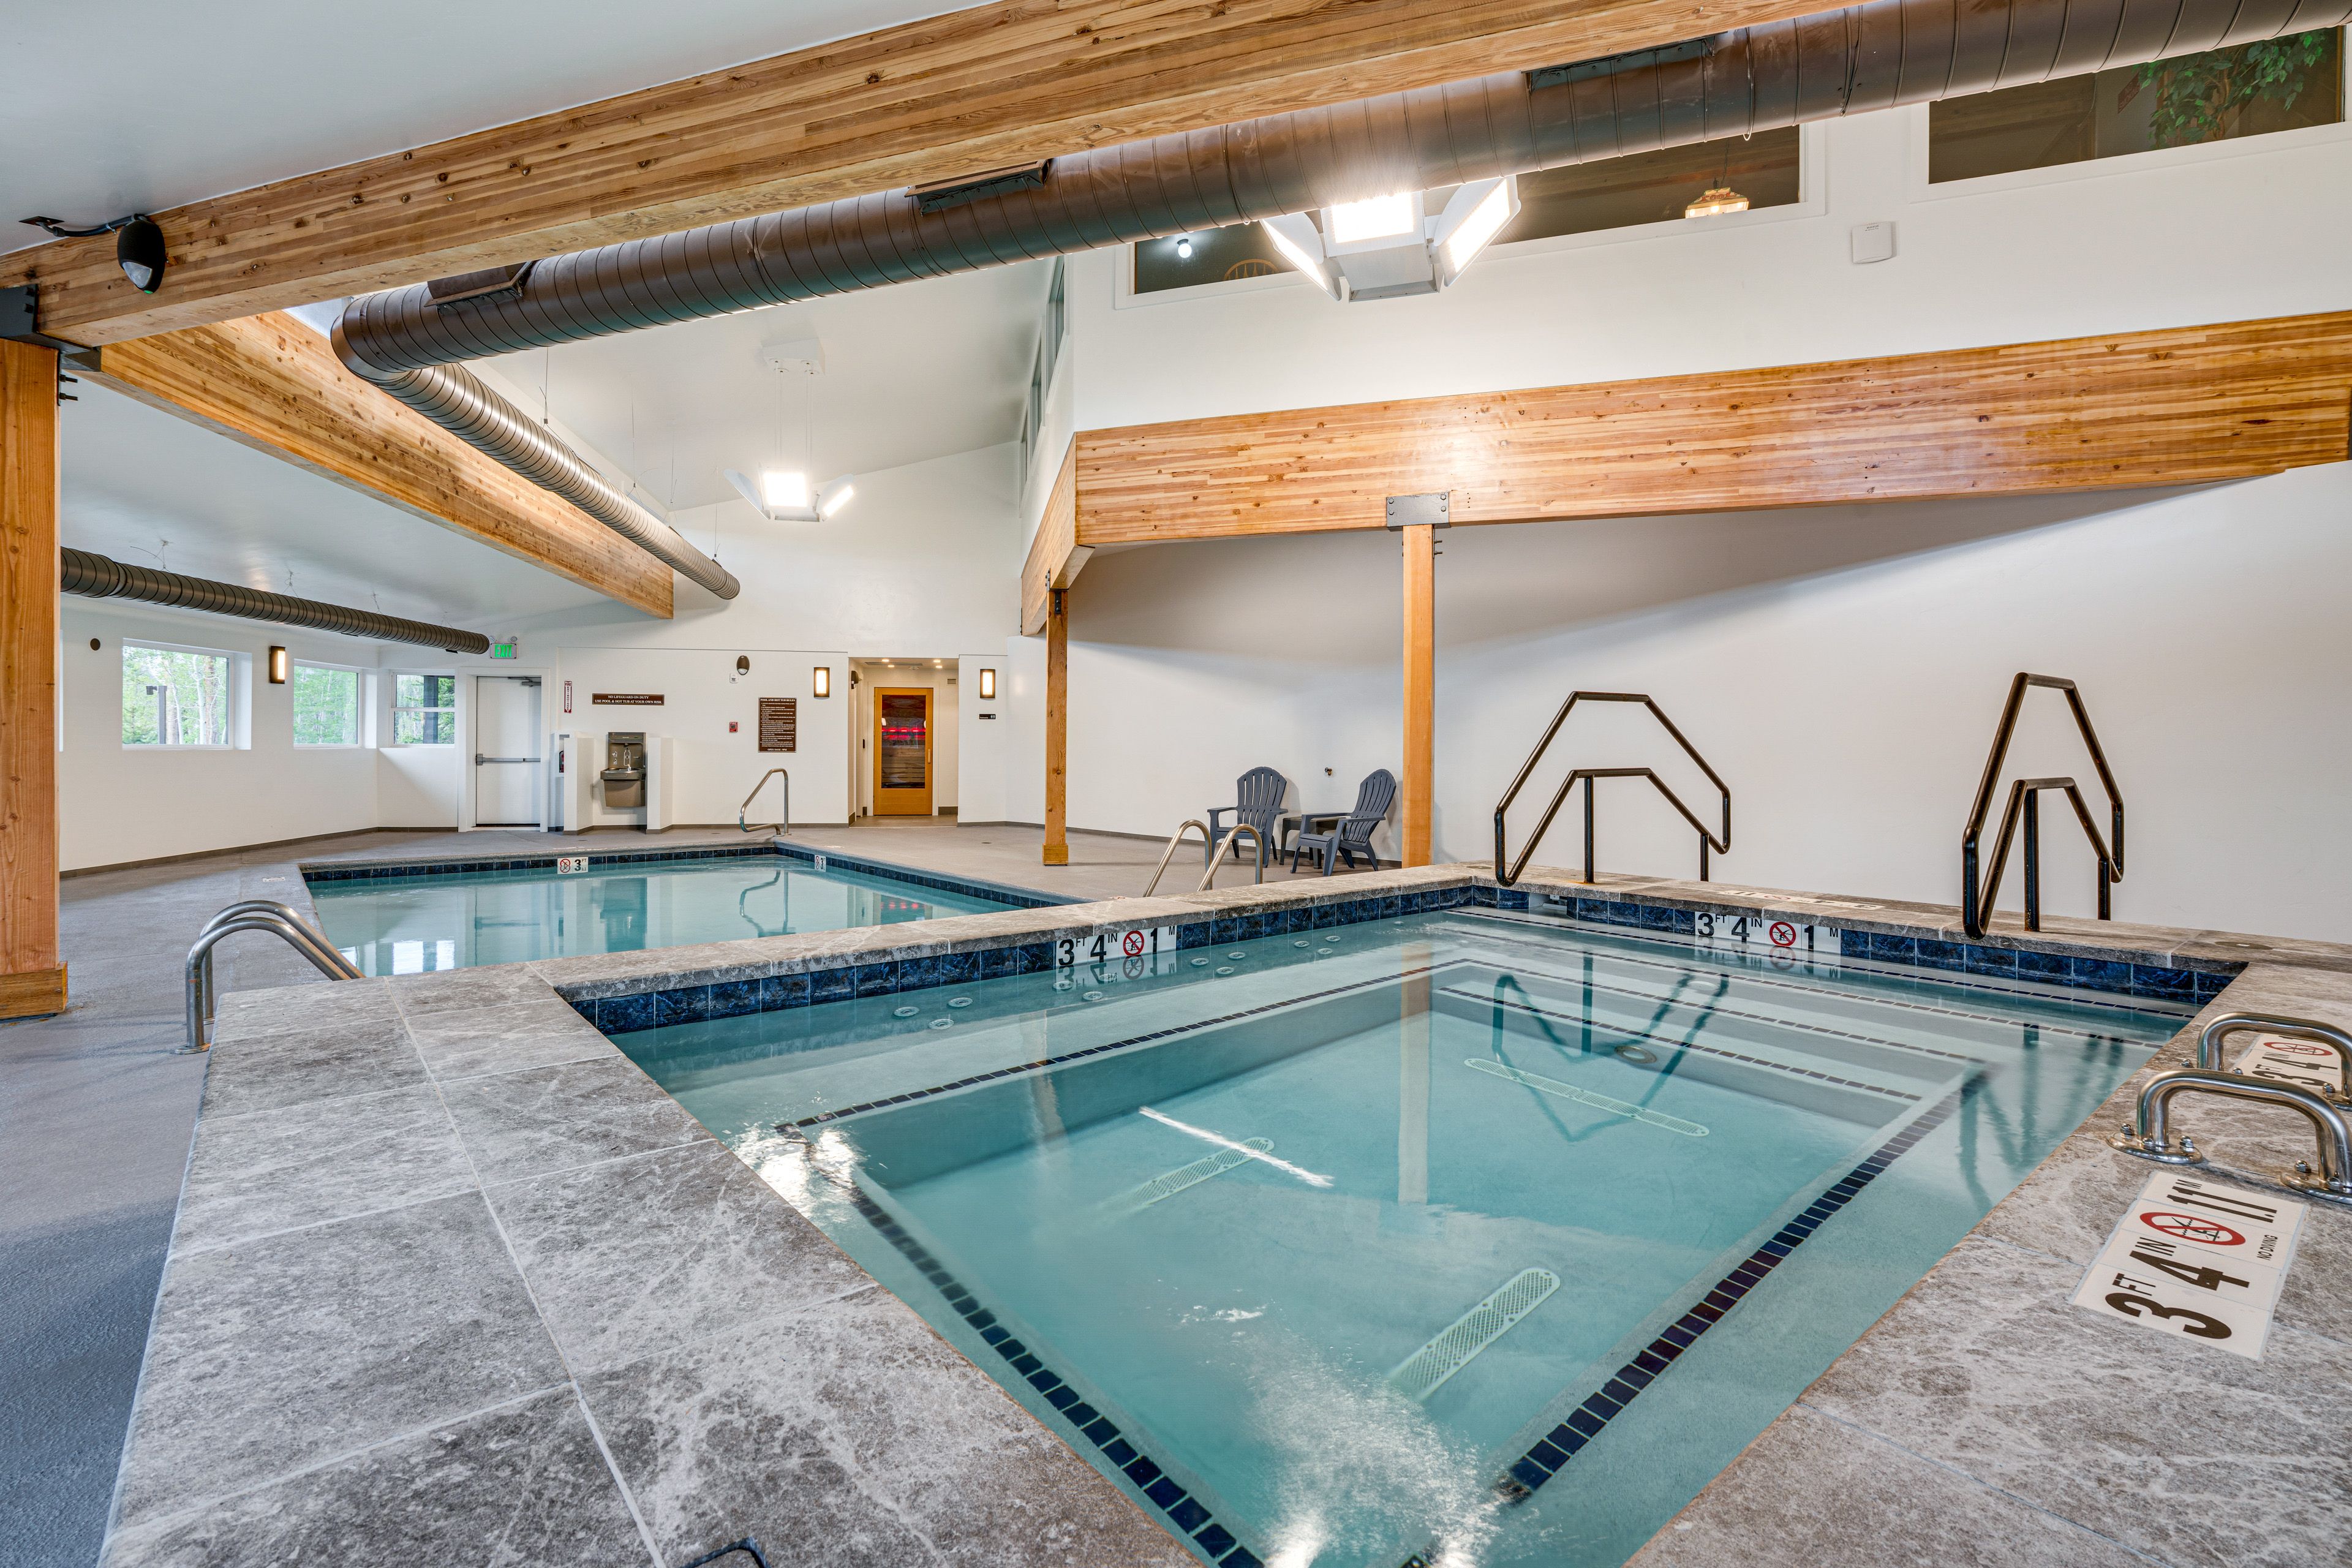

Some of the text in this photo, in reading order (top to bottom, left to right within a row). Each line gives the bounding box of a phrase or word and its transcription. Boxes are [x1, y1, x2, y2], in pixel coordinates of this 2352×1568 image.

[494, 644, 513, 657] EXIT
[1058, 925, 1175, 966] 3 FT 4 IN 1 M
[1697, 913, 1838, 951] 3 FT 4 IN 1 M
[2261, 1057, 2338, 1070] 4
[2252, 1070, 2327, 1087] 3
[2105, 1179, 2277, 1340] 3 FT 4 IN 1.1 M
[2256, 1234, 2278, 1261] NO DIVING
